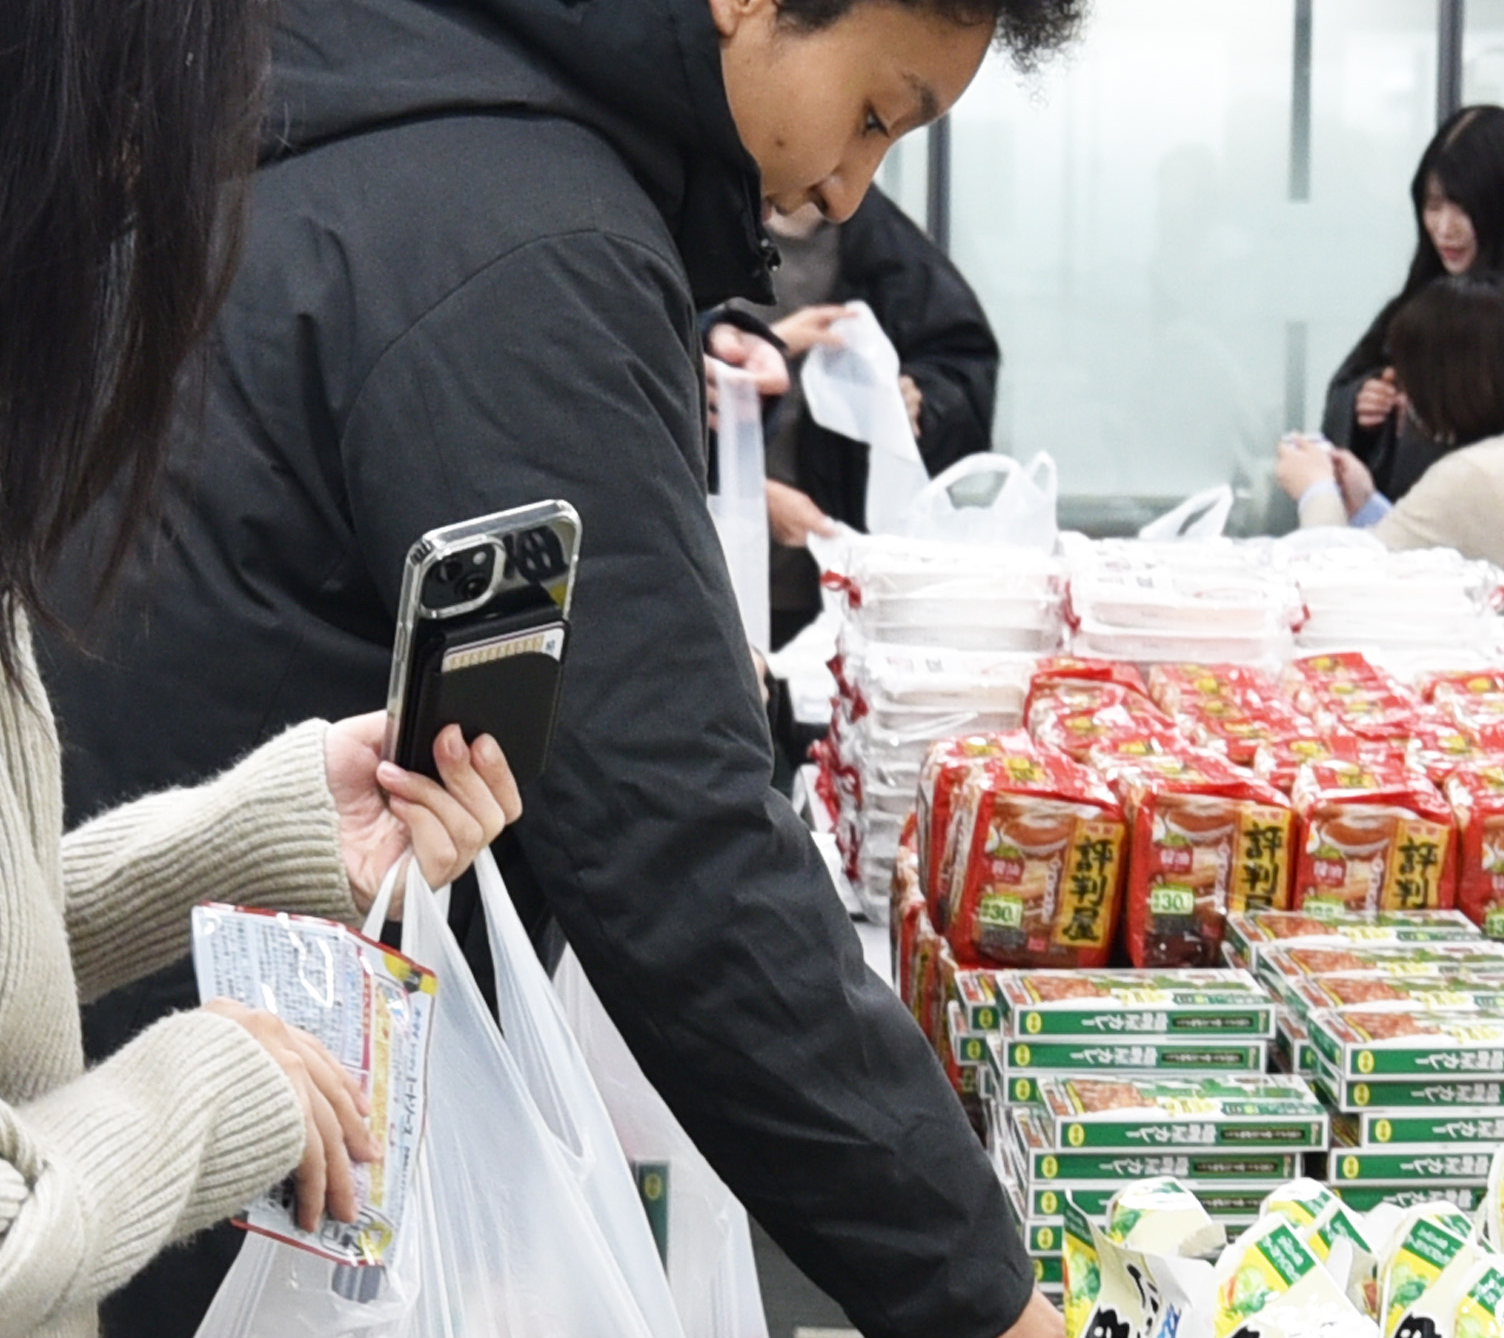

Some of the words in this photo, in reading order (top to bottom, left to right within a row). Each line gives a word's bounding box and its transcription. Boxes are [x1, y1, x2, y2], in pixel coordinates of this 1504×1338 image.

[1062, 835, 1114, 943] 評判屋
[1397, 834, 1440, 909] 評判
